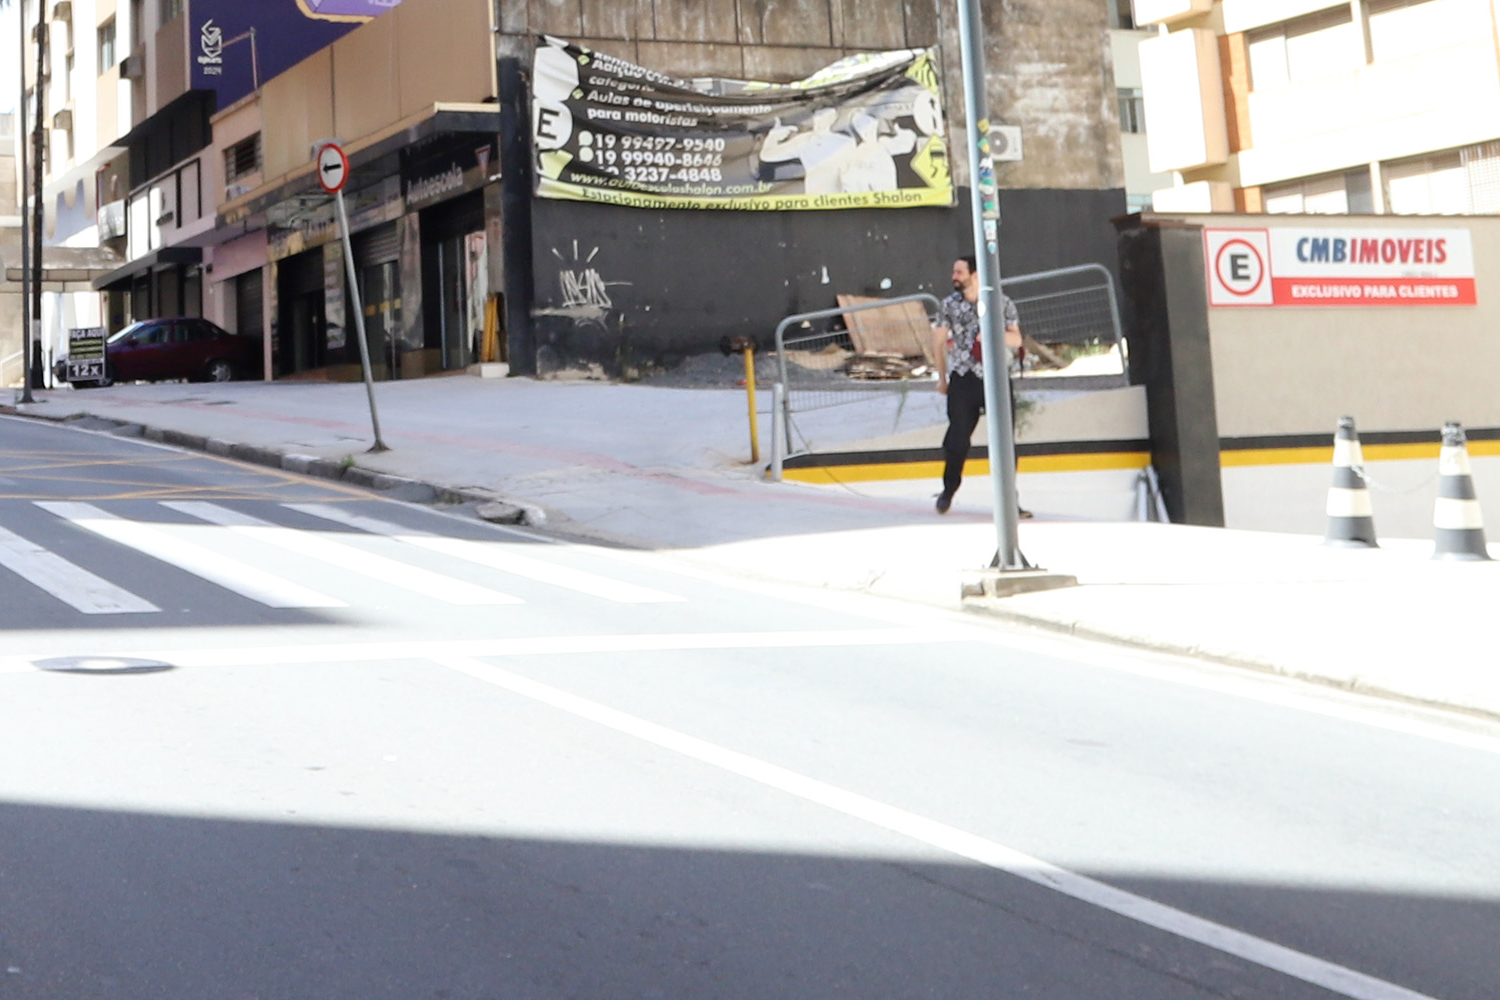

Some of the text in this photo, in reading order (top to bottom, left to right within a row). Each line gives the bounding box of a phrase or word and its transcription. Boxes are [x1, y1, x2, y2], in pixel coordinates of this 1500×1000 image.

[586, 89, 630, 106] Aulas
[586, 107, 699, 128] para motoristas
[594, 133, 616, 149] 19
[595, 150, 617, 166] 19
[624, 166, 723, 183] 3237-4848
[407, 161, 463, 206] Autoescola
[775, 199, 809, 211] para
[813, 194, 869, 206] clientes
[873, 190, 922, 204] Shalon
[1230, 254, 1251, 280] E
[1291, 285, 1458, 299] EXCLUSIVO PARA CLIENTES
